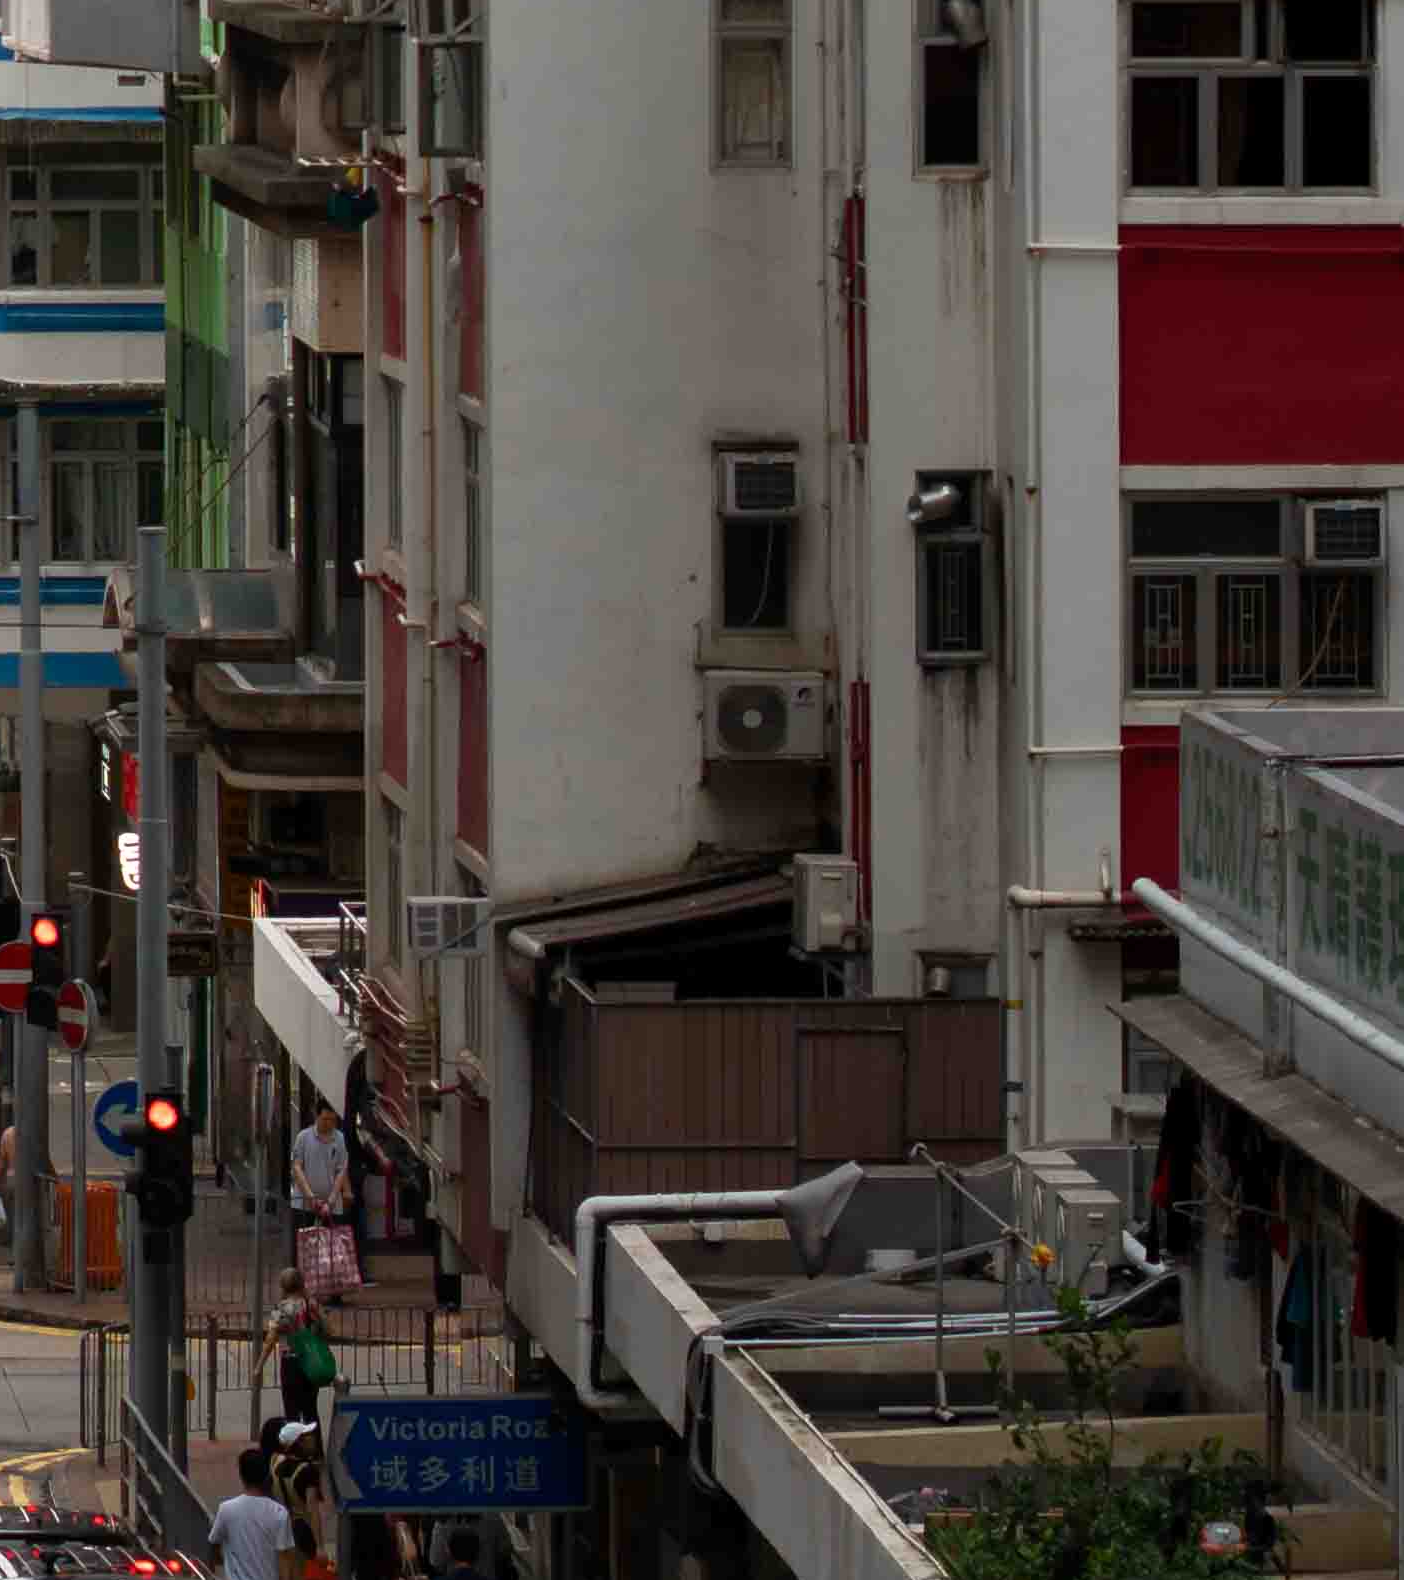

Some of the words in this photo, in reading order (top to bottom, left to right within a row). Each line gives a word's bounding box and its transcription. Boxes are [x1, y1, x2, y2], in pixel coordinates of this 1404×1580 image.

[368, 1415, 487, 1441] Victoria
[491, 1414, 567, 1440] Roa
[369, 1455, 545, 1496] 域多利道
